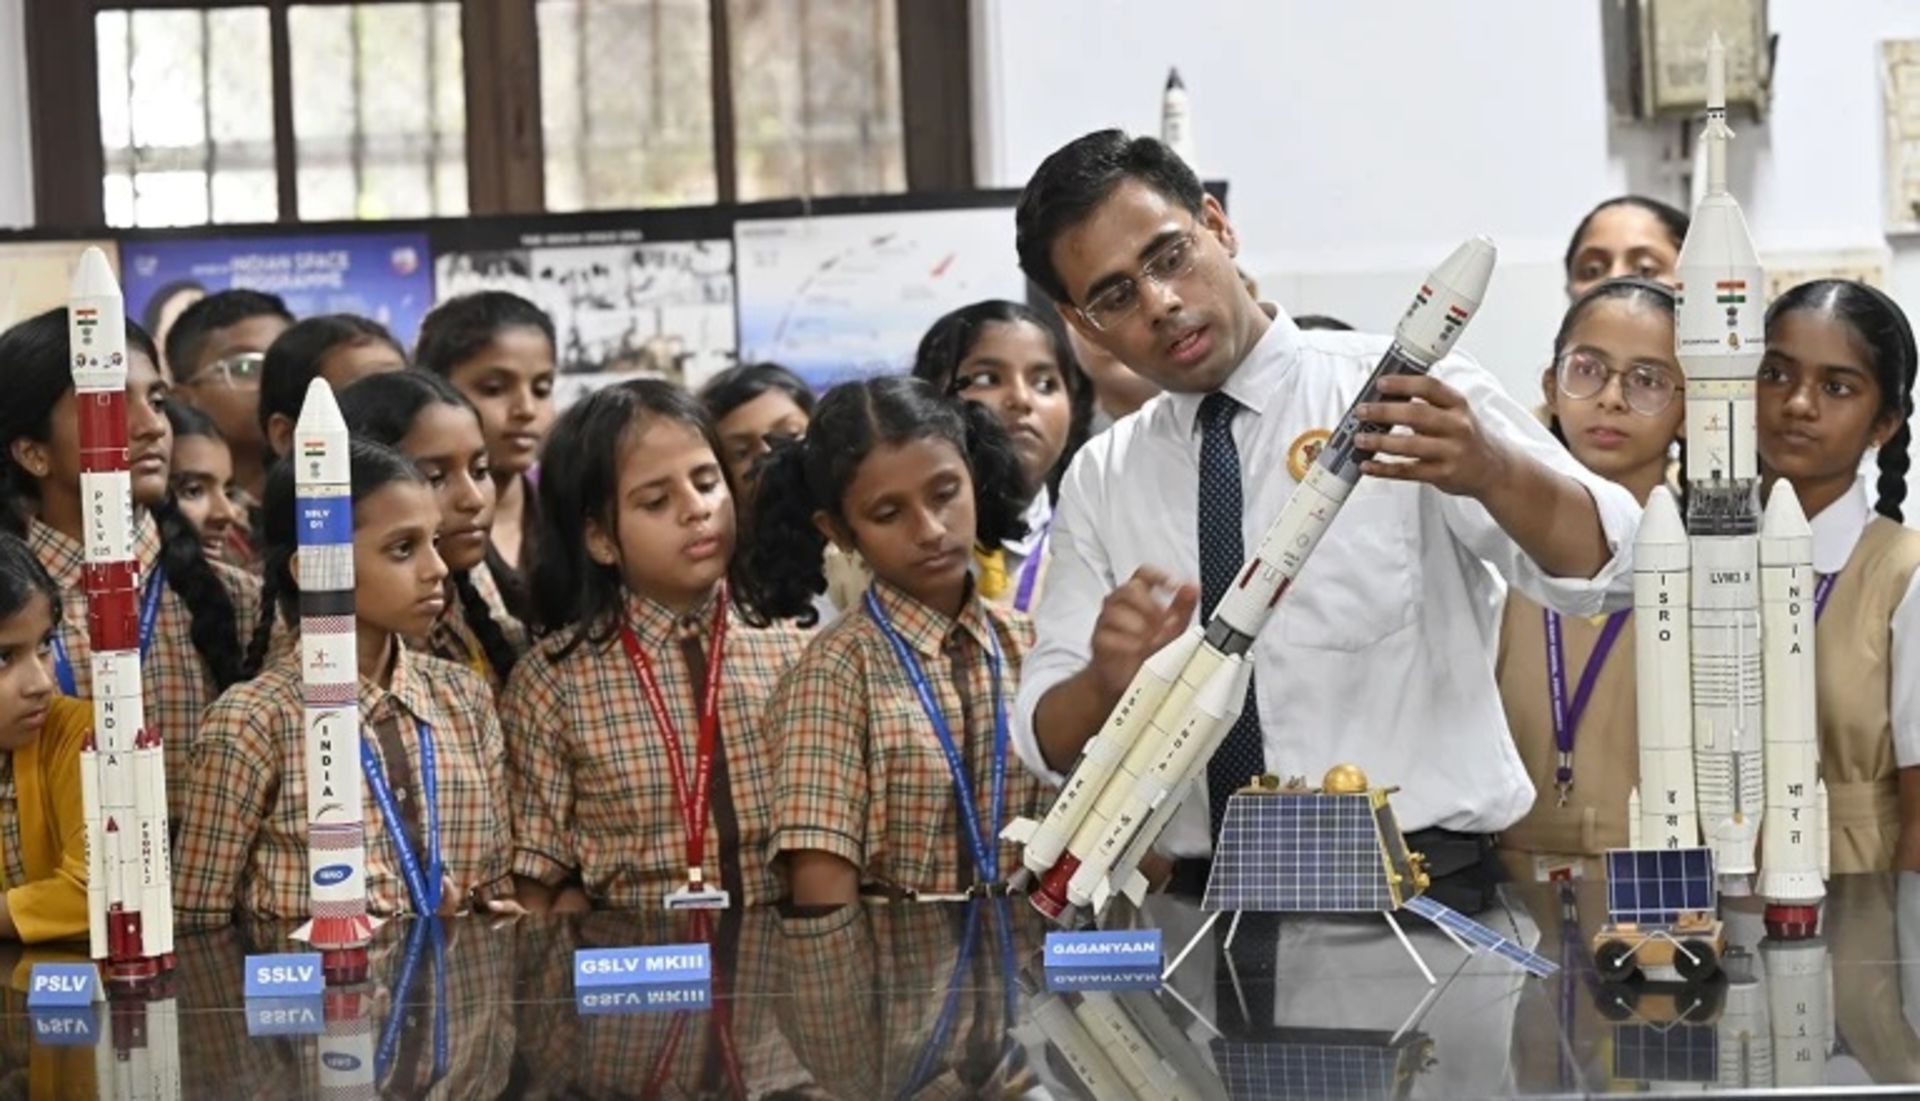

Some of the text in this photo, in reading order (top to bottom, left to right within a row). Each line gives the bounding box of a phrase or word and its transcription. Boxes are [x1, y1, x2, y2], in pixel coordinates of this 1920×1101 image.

[1658, 574, 1671, 642] ISRO
[1789, 567, 1801, 655] INDIA
[104, 684, 118, 767] INDIA
[320, 724, 334, 797] INDIA
[580, 954, 703, 975] GSLV MKIII
[1053, 942, 1156, 955] GAGANYAAN
[34, 974, 88, 993] PSLV
[256, 965, 314, 983] SSLV
